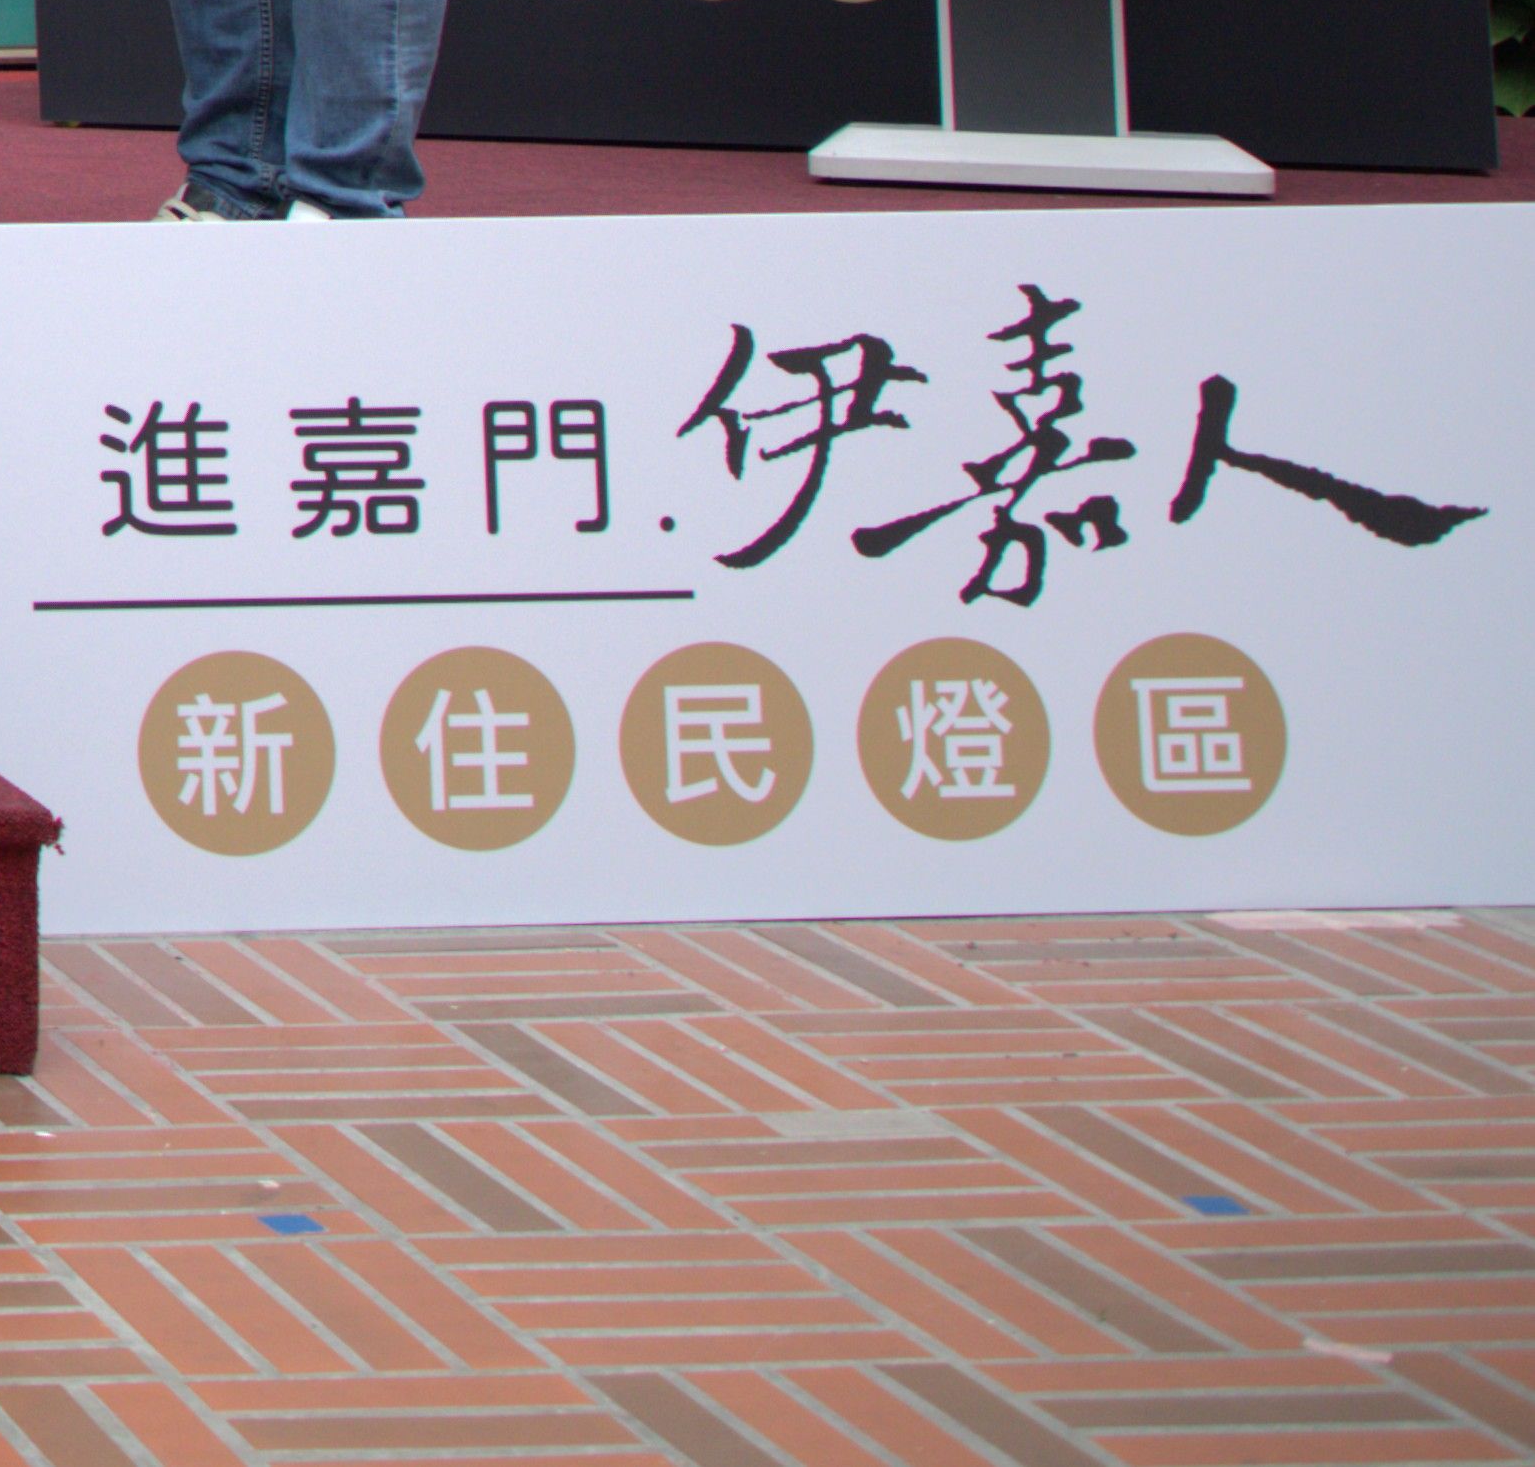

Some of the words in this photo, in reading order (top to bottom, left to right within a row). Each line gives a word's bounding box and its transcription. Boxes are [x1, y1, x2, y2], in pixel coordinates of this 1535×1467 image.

[174, 673, 1254, 819] 新住民燈區
